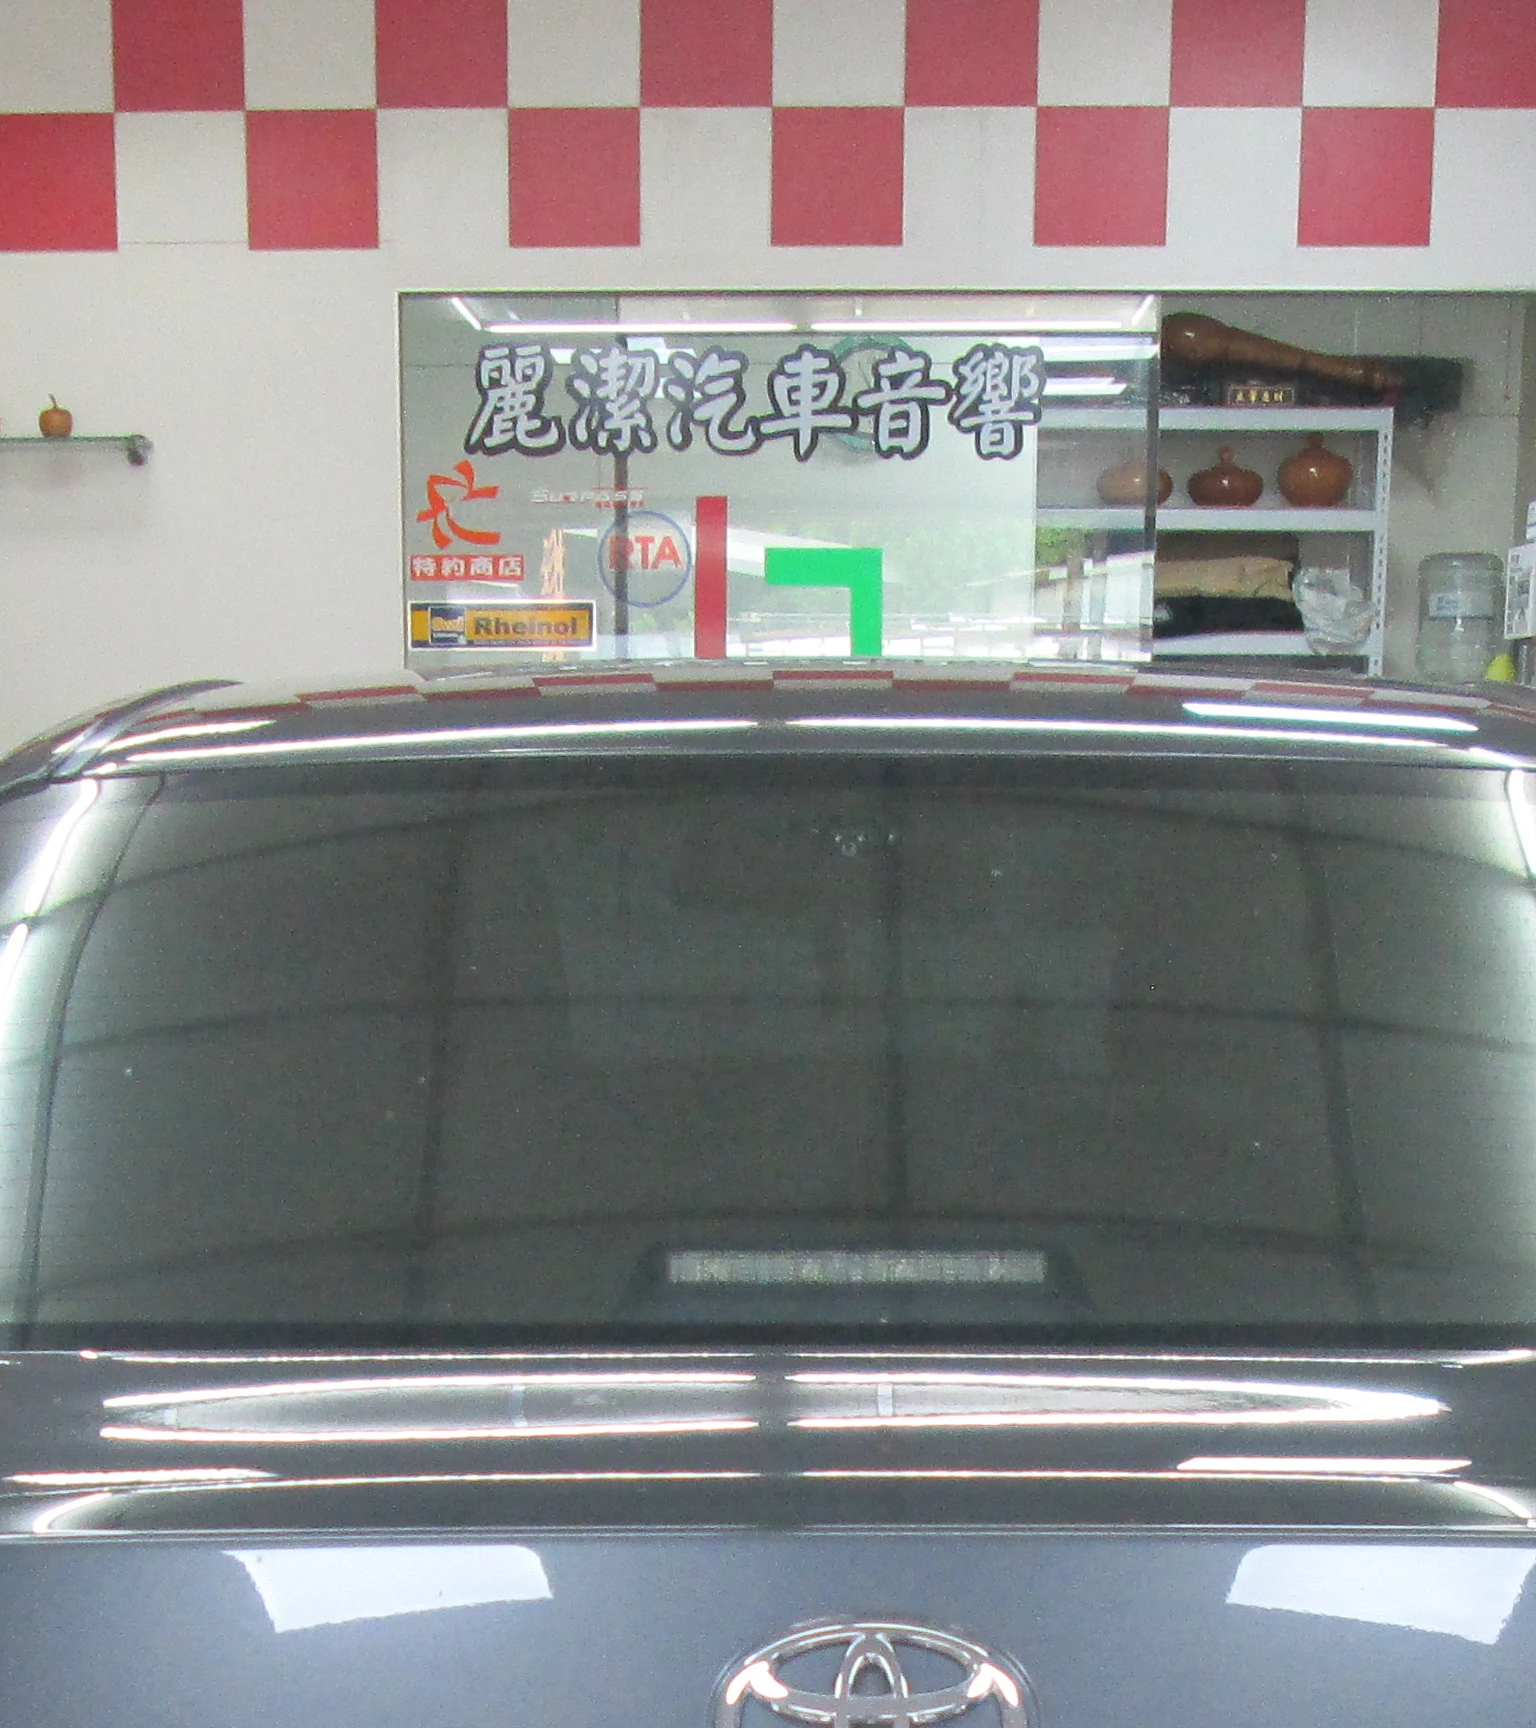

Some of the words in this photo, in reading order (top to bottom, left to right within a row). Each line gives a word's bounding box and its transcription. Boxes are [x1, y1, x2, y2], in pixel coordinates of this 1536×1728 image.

[463, 342, 1046, 463] 麗潔汽車音響
[412, 556, 523, 578] 特約商店
[609, 535, 683, 571] RTA
[473, 616, 579, 636] Rheinol
